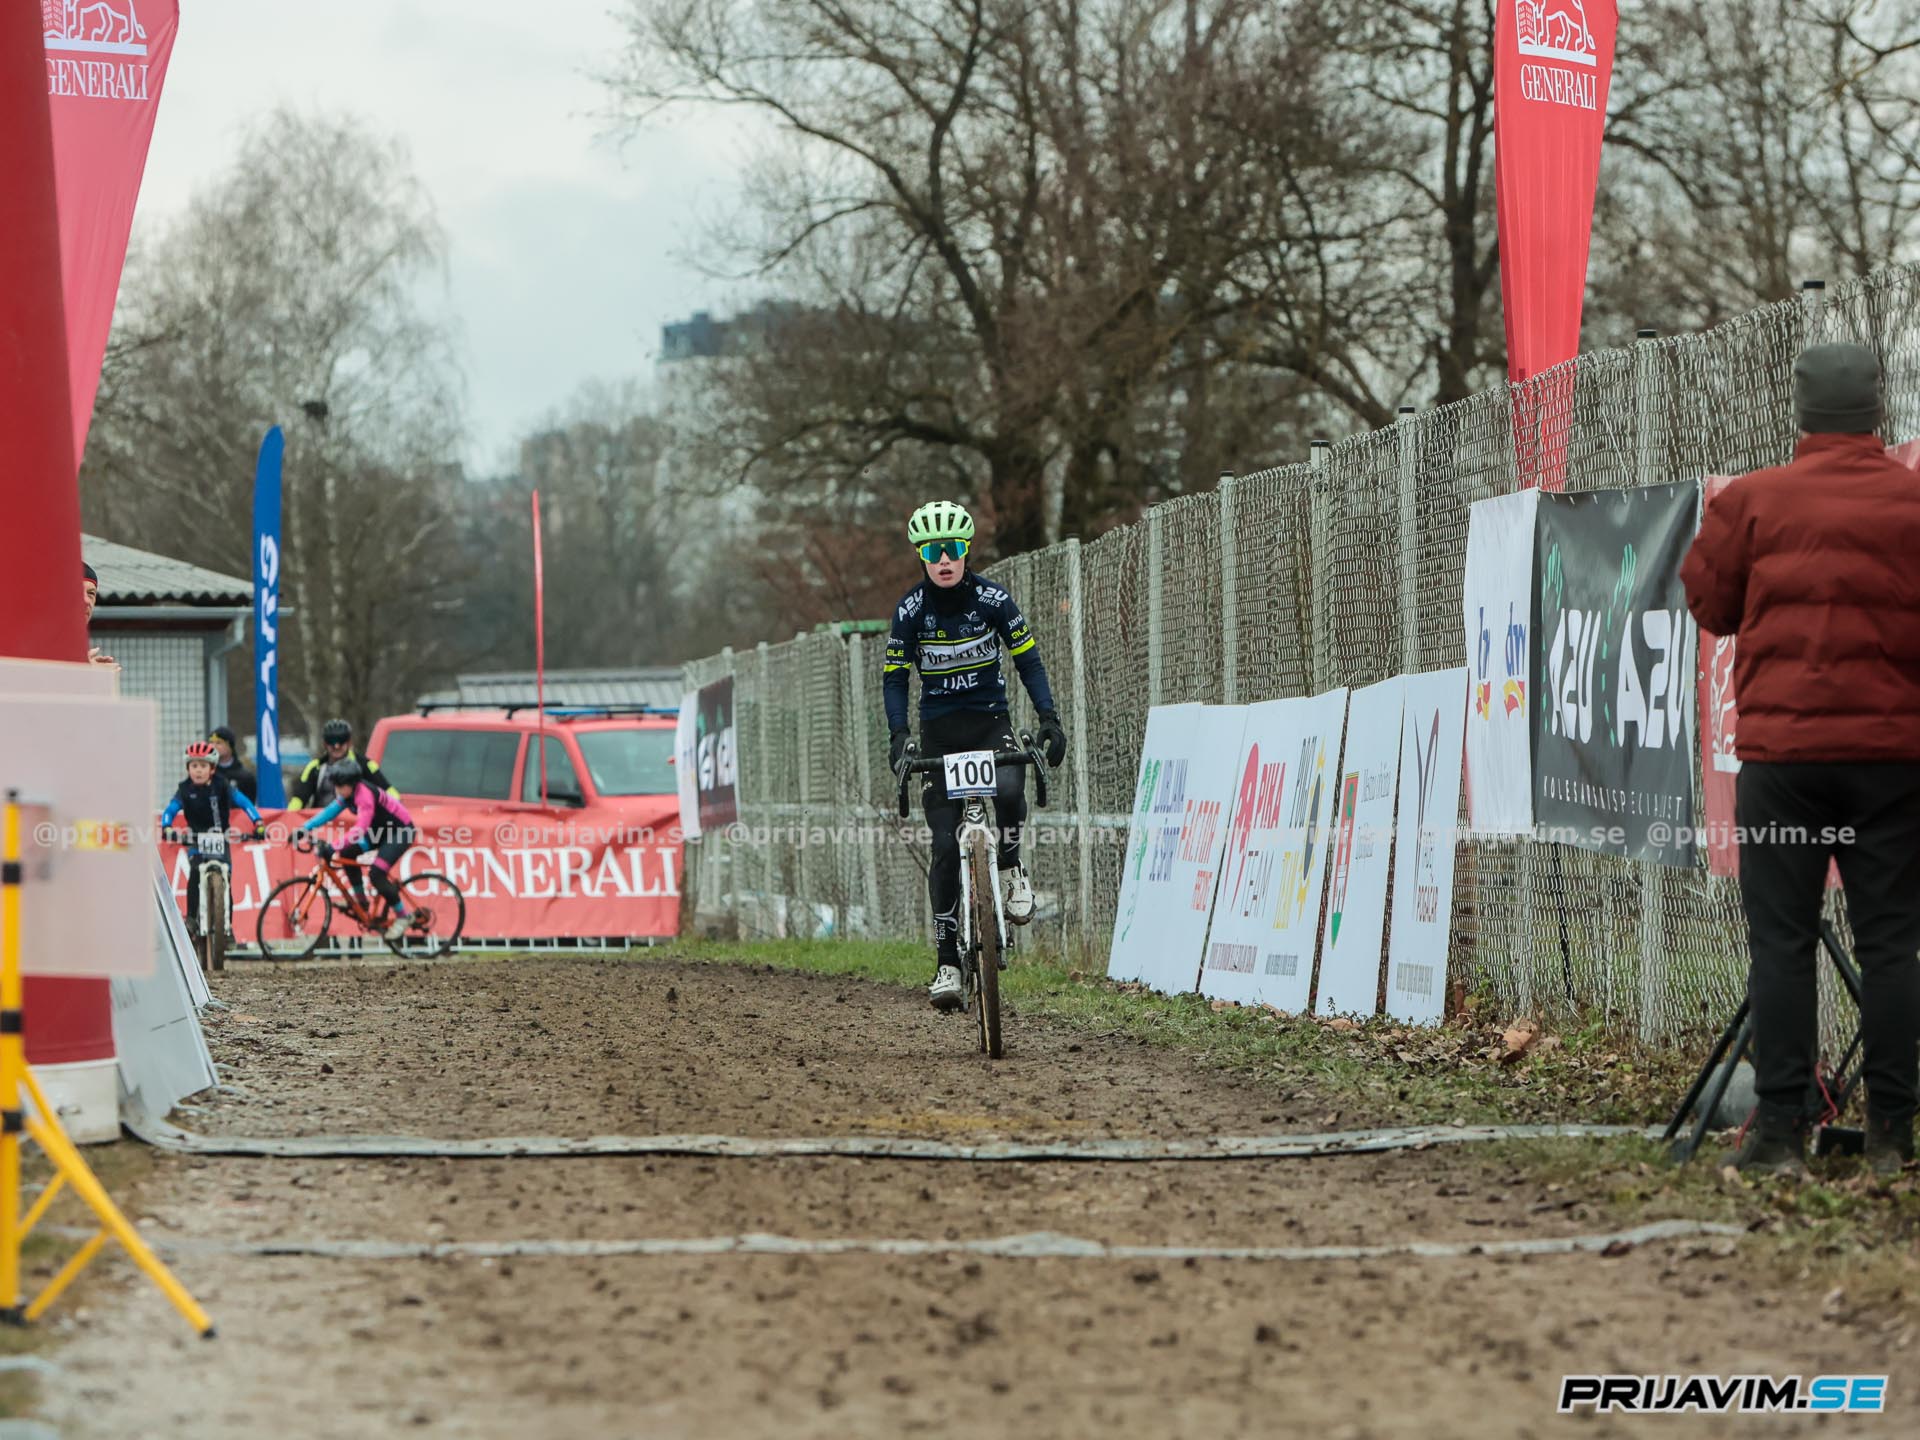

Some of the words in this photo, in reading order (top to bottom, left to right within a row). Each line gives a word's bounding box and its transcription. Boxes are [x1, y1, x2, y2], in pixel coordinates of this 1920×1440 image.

[47, 58, 149, 100] GENERALI
[1520, 63, 1597, 111] GENERALI
[898, 588, 923, 622] A2U
[978, 594, 1002, 608] BIKES
[950, 760, 993, 787] 100
[1254, 762, 1286, 830] PIKA
[399, 845, 682, 898] GENERALI
[1240, 850, 1275, 918] TEAM
